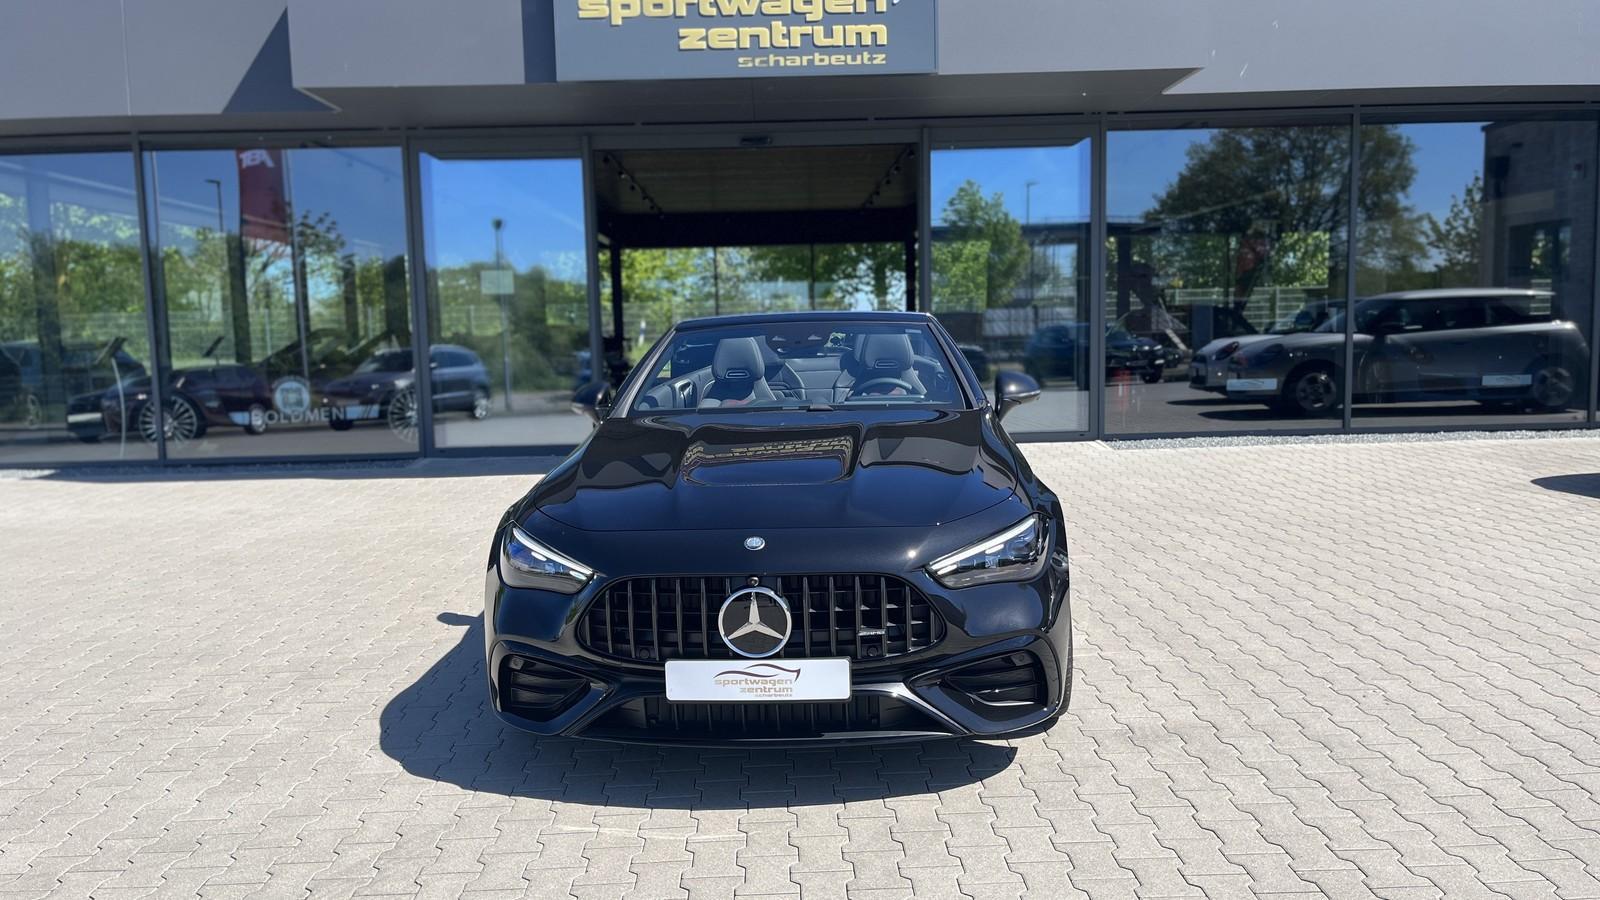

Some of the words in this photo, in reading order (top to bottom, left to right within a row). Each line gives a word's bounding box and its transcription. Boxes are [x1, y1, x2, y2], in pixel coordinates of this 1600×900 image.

[678, 20, 888, 50] zentrum
[737, 51, 887, 68] scharbeutz
[251, 407, 344, 425] BOLDMEN
[715, 678, 793, 687] sportwagen
[740, 686, 793, 694] zentrum
